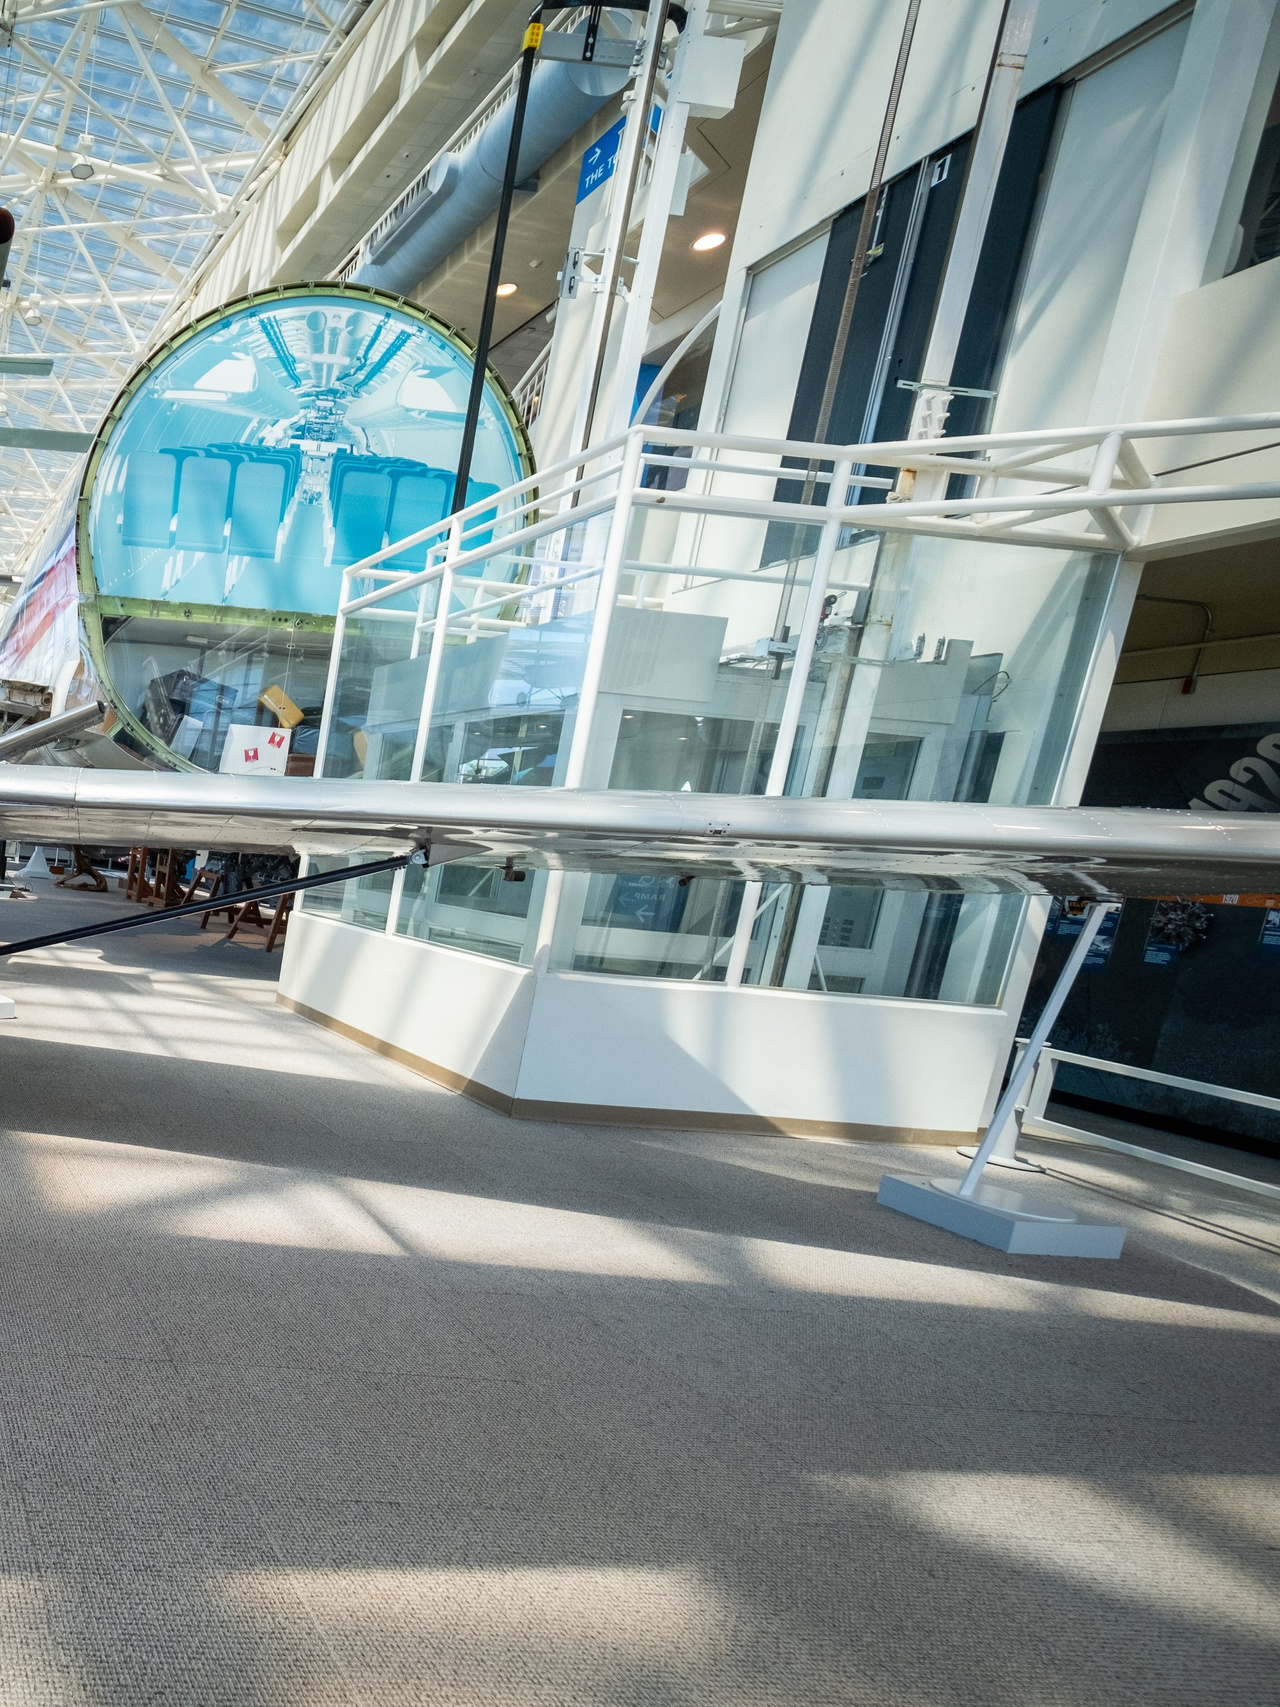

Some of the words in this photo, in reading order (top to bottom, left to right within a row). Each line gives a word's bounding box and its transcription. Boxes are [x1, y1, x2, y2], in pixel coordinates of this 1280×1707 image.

[584, 163, 604, 188] THE
[937, 157, 947, 183] 1
[1222, 894, 1239, 904] 1920
